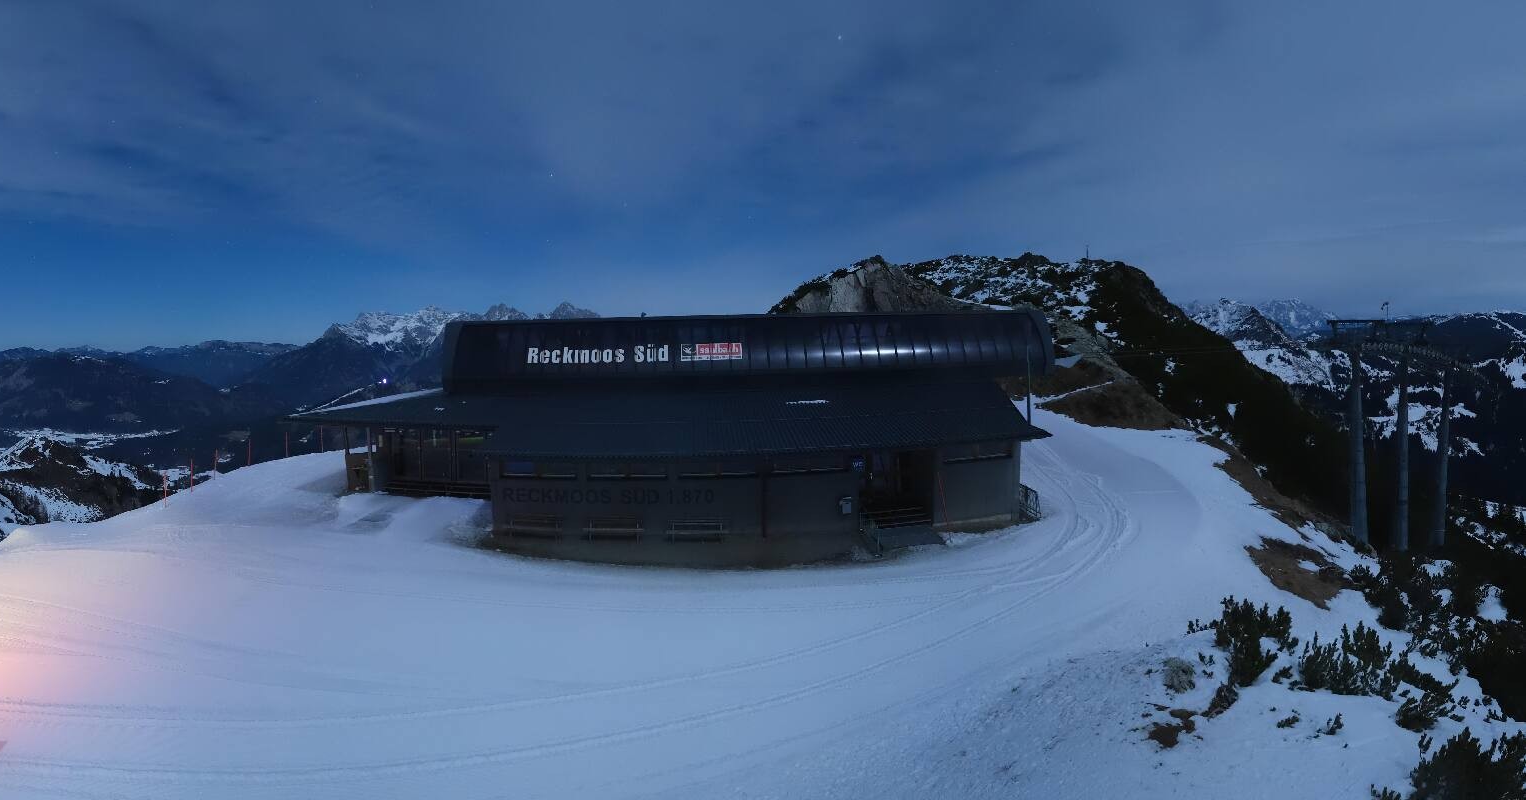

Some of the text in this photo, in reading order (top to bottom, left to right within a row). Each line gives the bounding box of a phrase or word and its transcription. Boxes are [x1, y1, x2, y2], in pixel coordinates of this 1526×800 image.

[527, 344, 669, 364] Reckmoos Süd
[501, 487, 611, 504] RECKMOOS
[666, 488, 715, 504] 1.870
